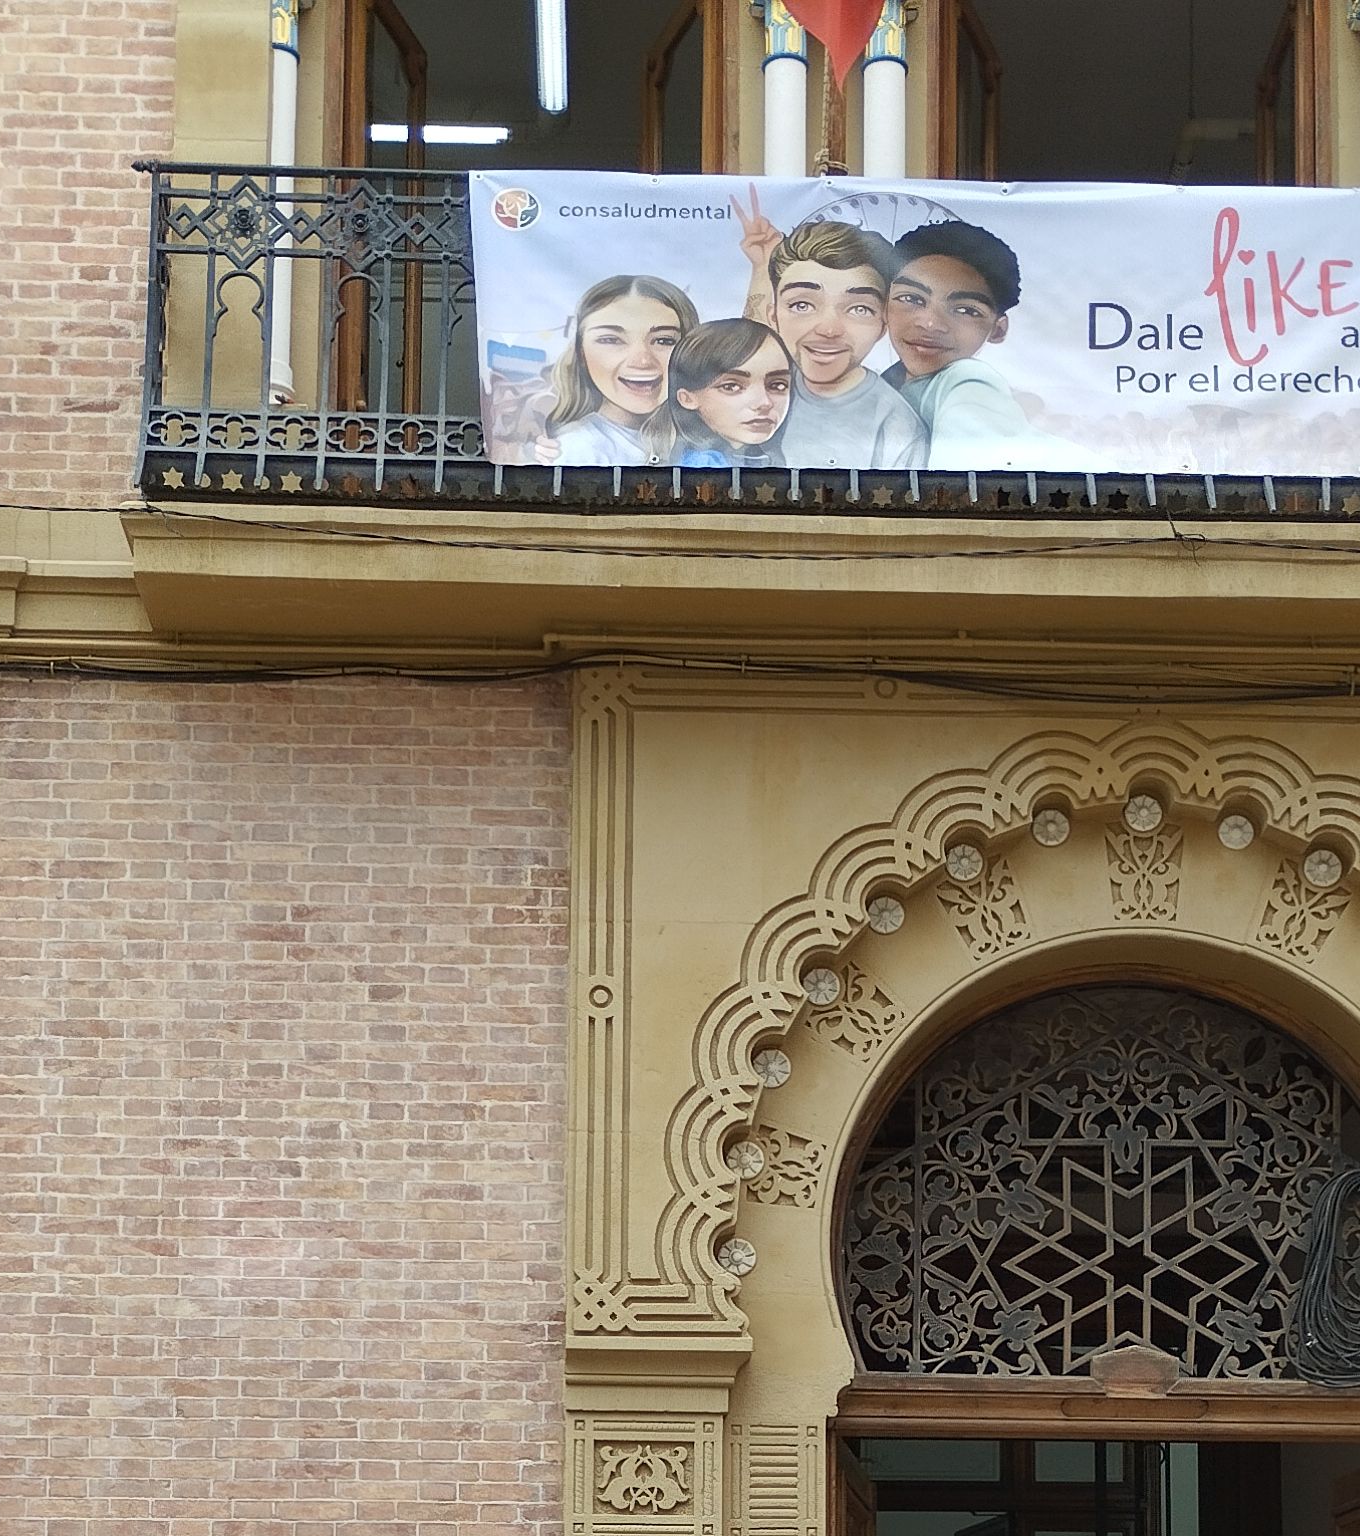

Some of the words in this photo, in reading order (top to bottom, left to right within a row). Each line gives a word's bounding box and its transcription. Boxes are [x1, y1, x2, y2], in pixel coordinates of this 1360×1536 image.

[559, 202, 732, 220] consaludmental
[1087, 302, 1204, 350] Dale
[1340, 326, 1360, 349] a
[1115, 365, 1177, 393] Por
[1189, 364, 1220, 392] el
